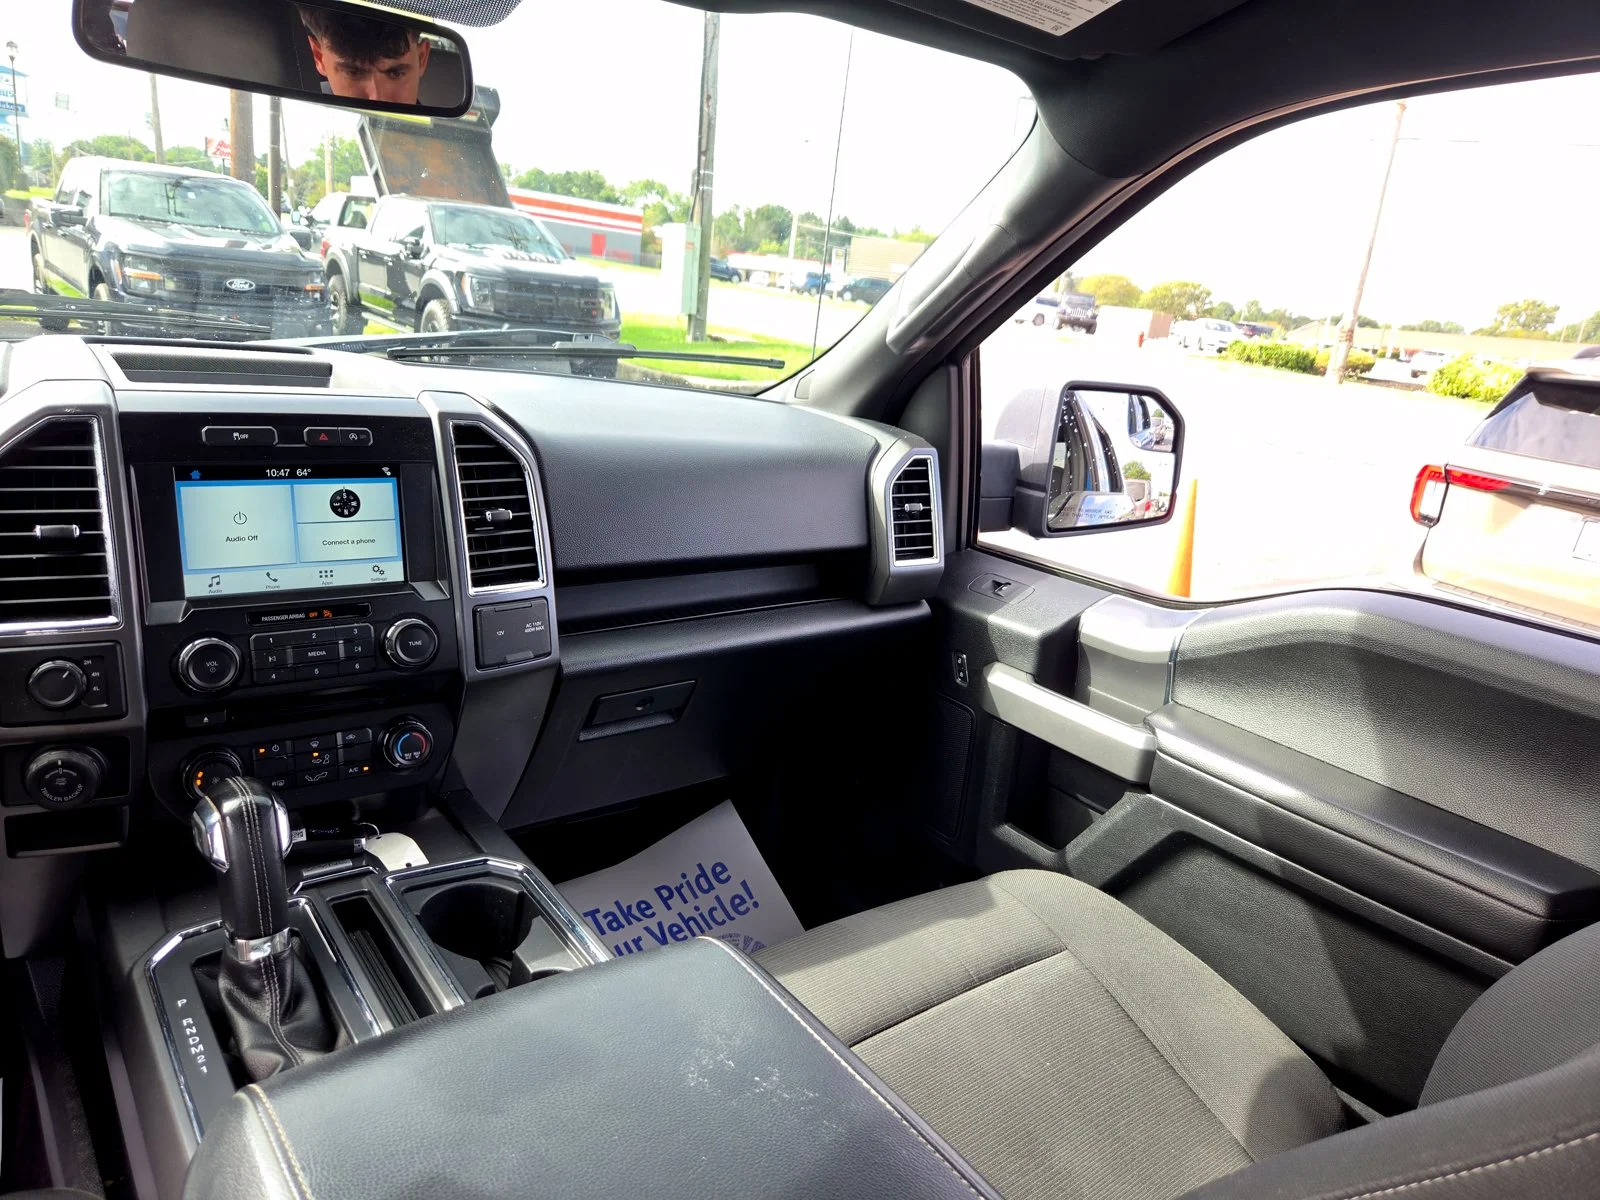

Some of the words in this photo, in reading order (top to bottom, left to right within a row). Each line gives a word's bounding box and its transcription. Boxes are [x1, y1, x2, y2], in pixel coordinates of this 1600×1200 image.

[265, 468, 290, 478] 10:47
[296, 467, 311, 477] 64°
[261, 614, 289, 622] PASSENGER
[40, 787, 63, 802] TRAILER
[64, 783, 84, 802] BACKUP
[582, 898, 657, 937] Take
[653, 860, 733, 912] Pride
[613, 933, 644, 958] ur
[642, 879, 760, 947] Vehicle!
[177, 999, 187, 1007] P
[182, 1018, 193, 1026] R
[185, 1026, 197, 1035] N
[189, 1037, 199, 1045] D
[191, 1044, 204, 1054] M
[197, 1055, 206, 1063] 2
